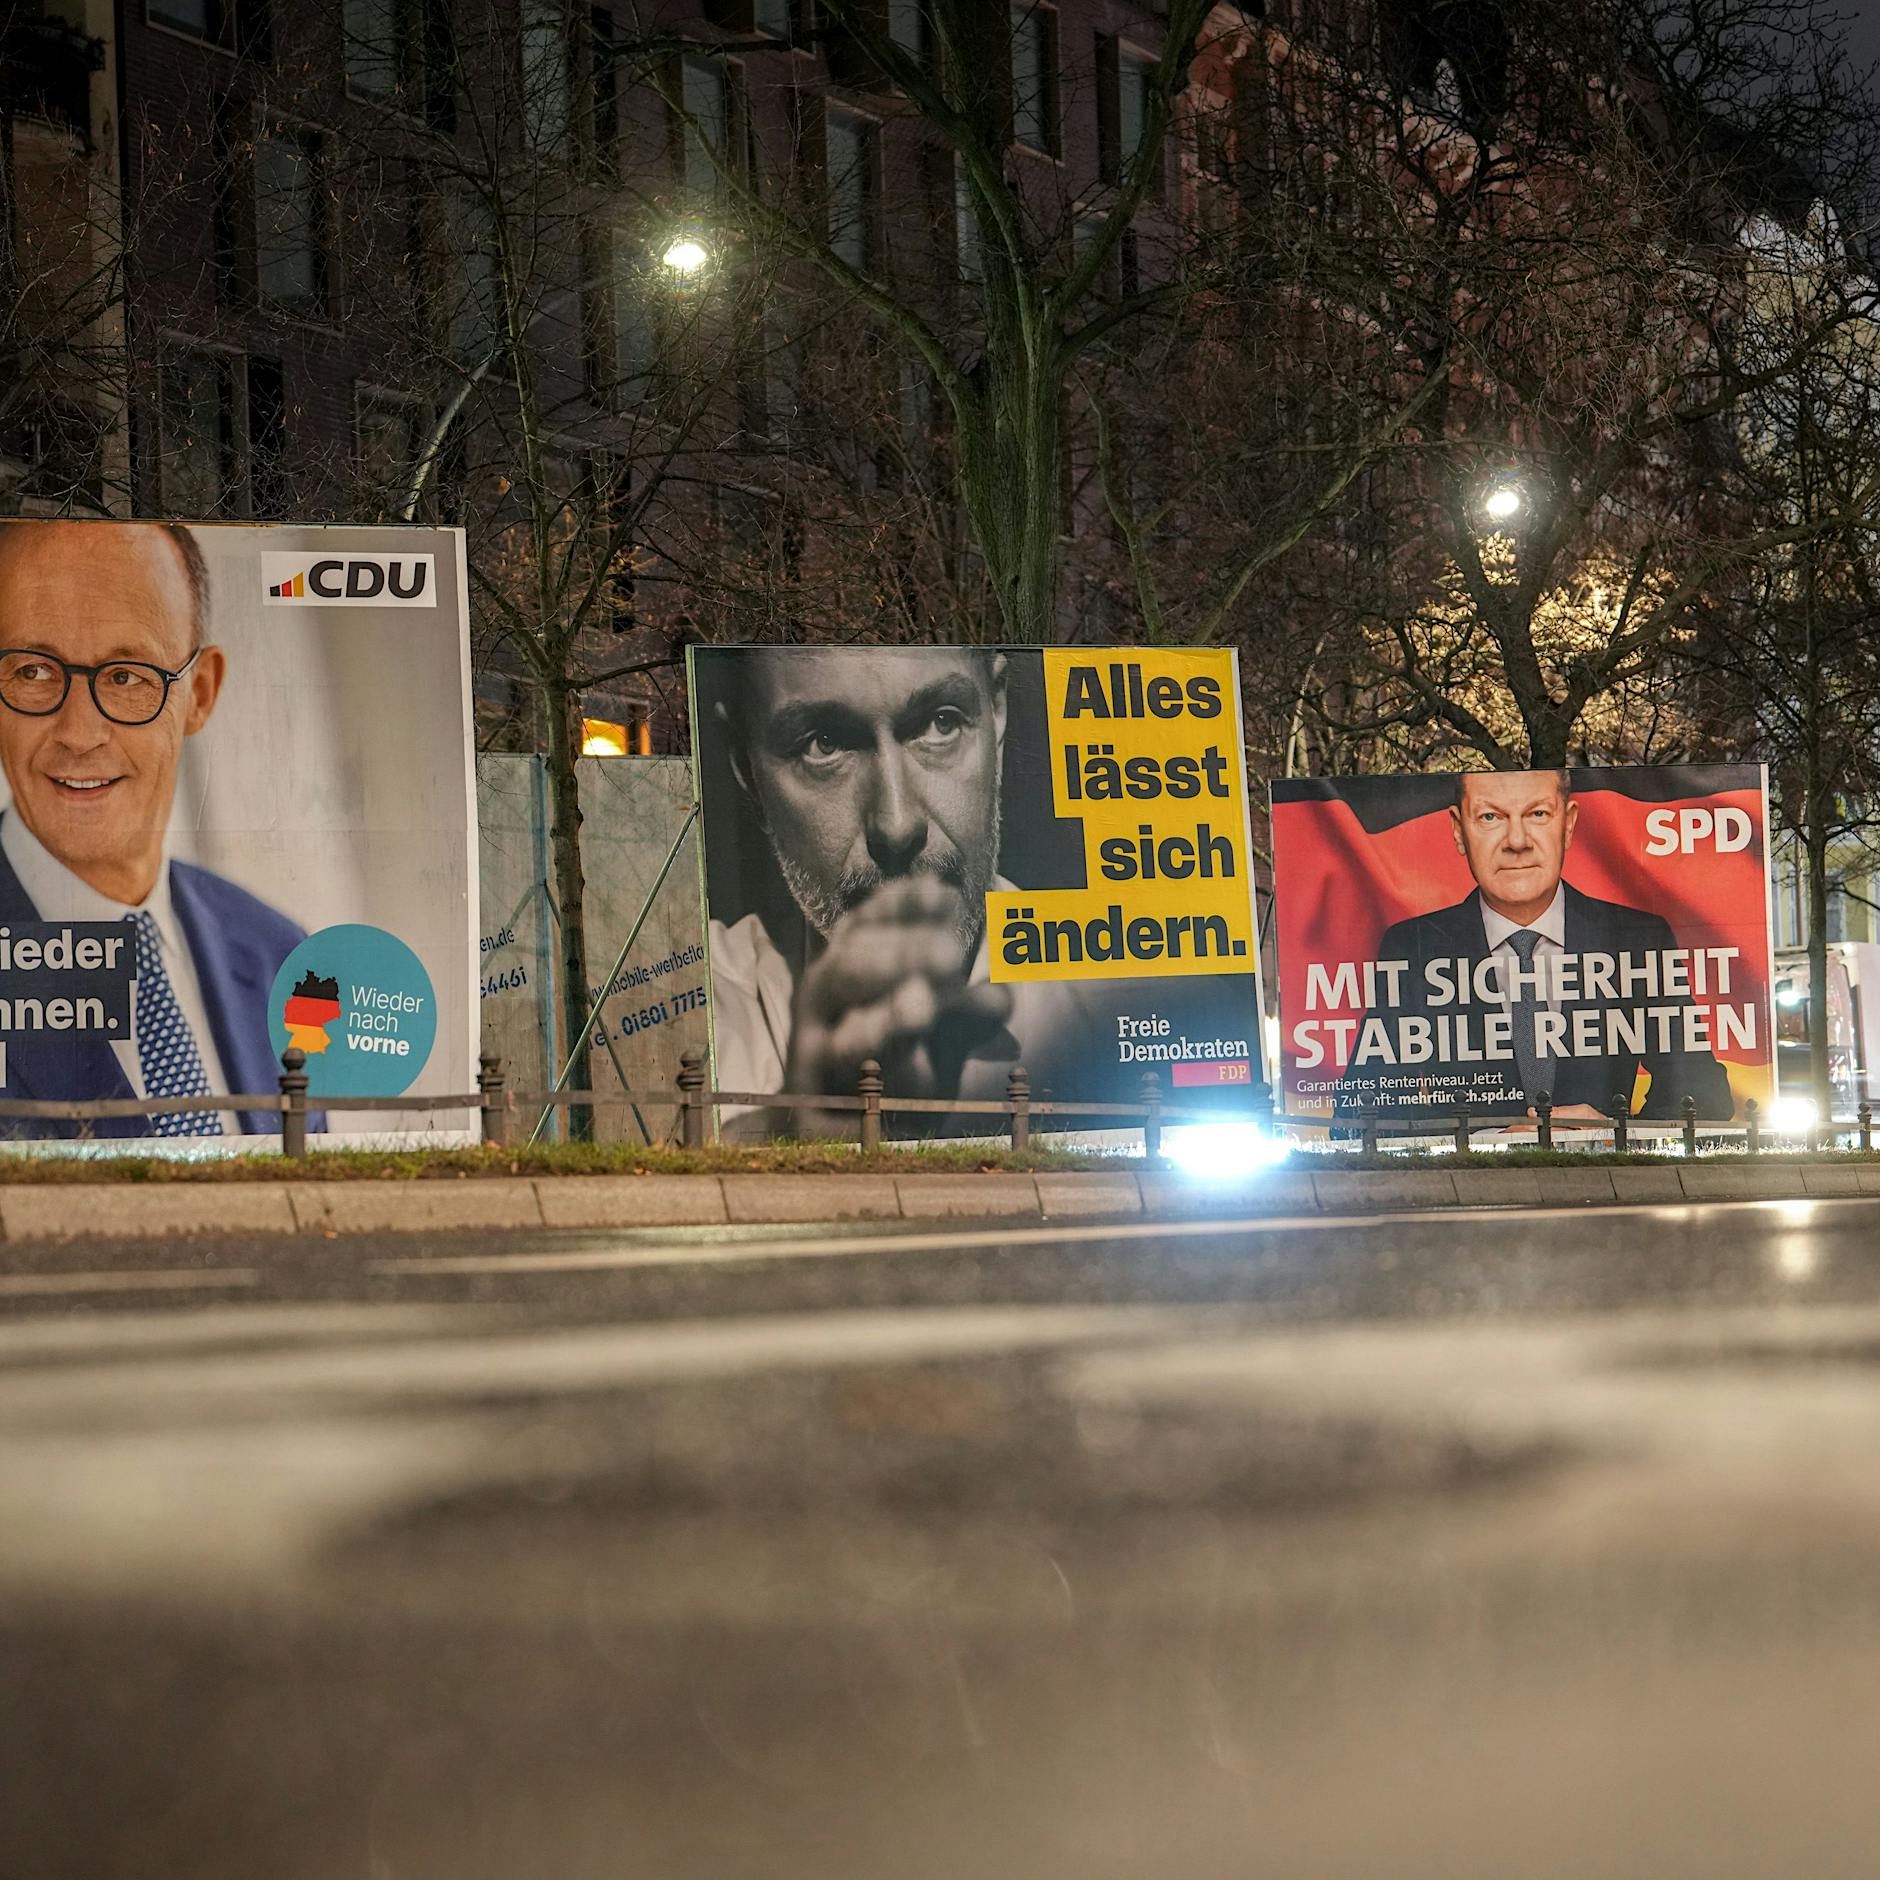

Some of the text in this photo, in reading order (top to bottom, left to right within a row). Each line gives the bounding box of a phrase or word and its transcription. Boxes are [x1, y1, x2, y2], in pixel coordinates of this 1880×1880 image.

[308, 560, 427, 599] CDU
[1063, 664, 1222, 719] Alles
[1064, 745, 1229, 800] lässt
[1645, 807, 1752, 856] SPD
[1100, 824, 1235, 880] sich
[1002, 905, 1246, 965] ändern.
[1305, 947, 1740, 1011] MIT SICHERHEIT
[351, 985, 424, 1014] Wieder
[671, 986, 707, 1016] 7775
[349, 1008, 398, 1033] nach
[1117, 1014, 1171, 1038] Freie
[346, 1033, 410, 1057] vorne
[1118, 1037, 1249, 1063] Demokraten
[1294, 1011, 1514, 1069] STABILE
[1535, 1003, 1757, 1059] RENTEN
[1218, 1065, 1248, 1080] FDP
[1296, 1072, 1503, 1092] Garantiertes Rentenniveau. Jetzt
[1298, 1097, 1322, 1109] und
[1326, 1096, 1337, 1108] in
[1341, 1092, 1395, 1108] Zuknft:
